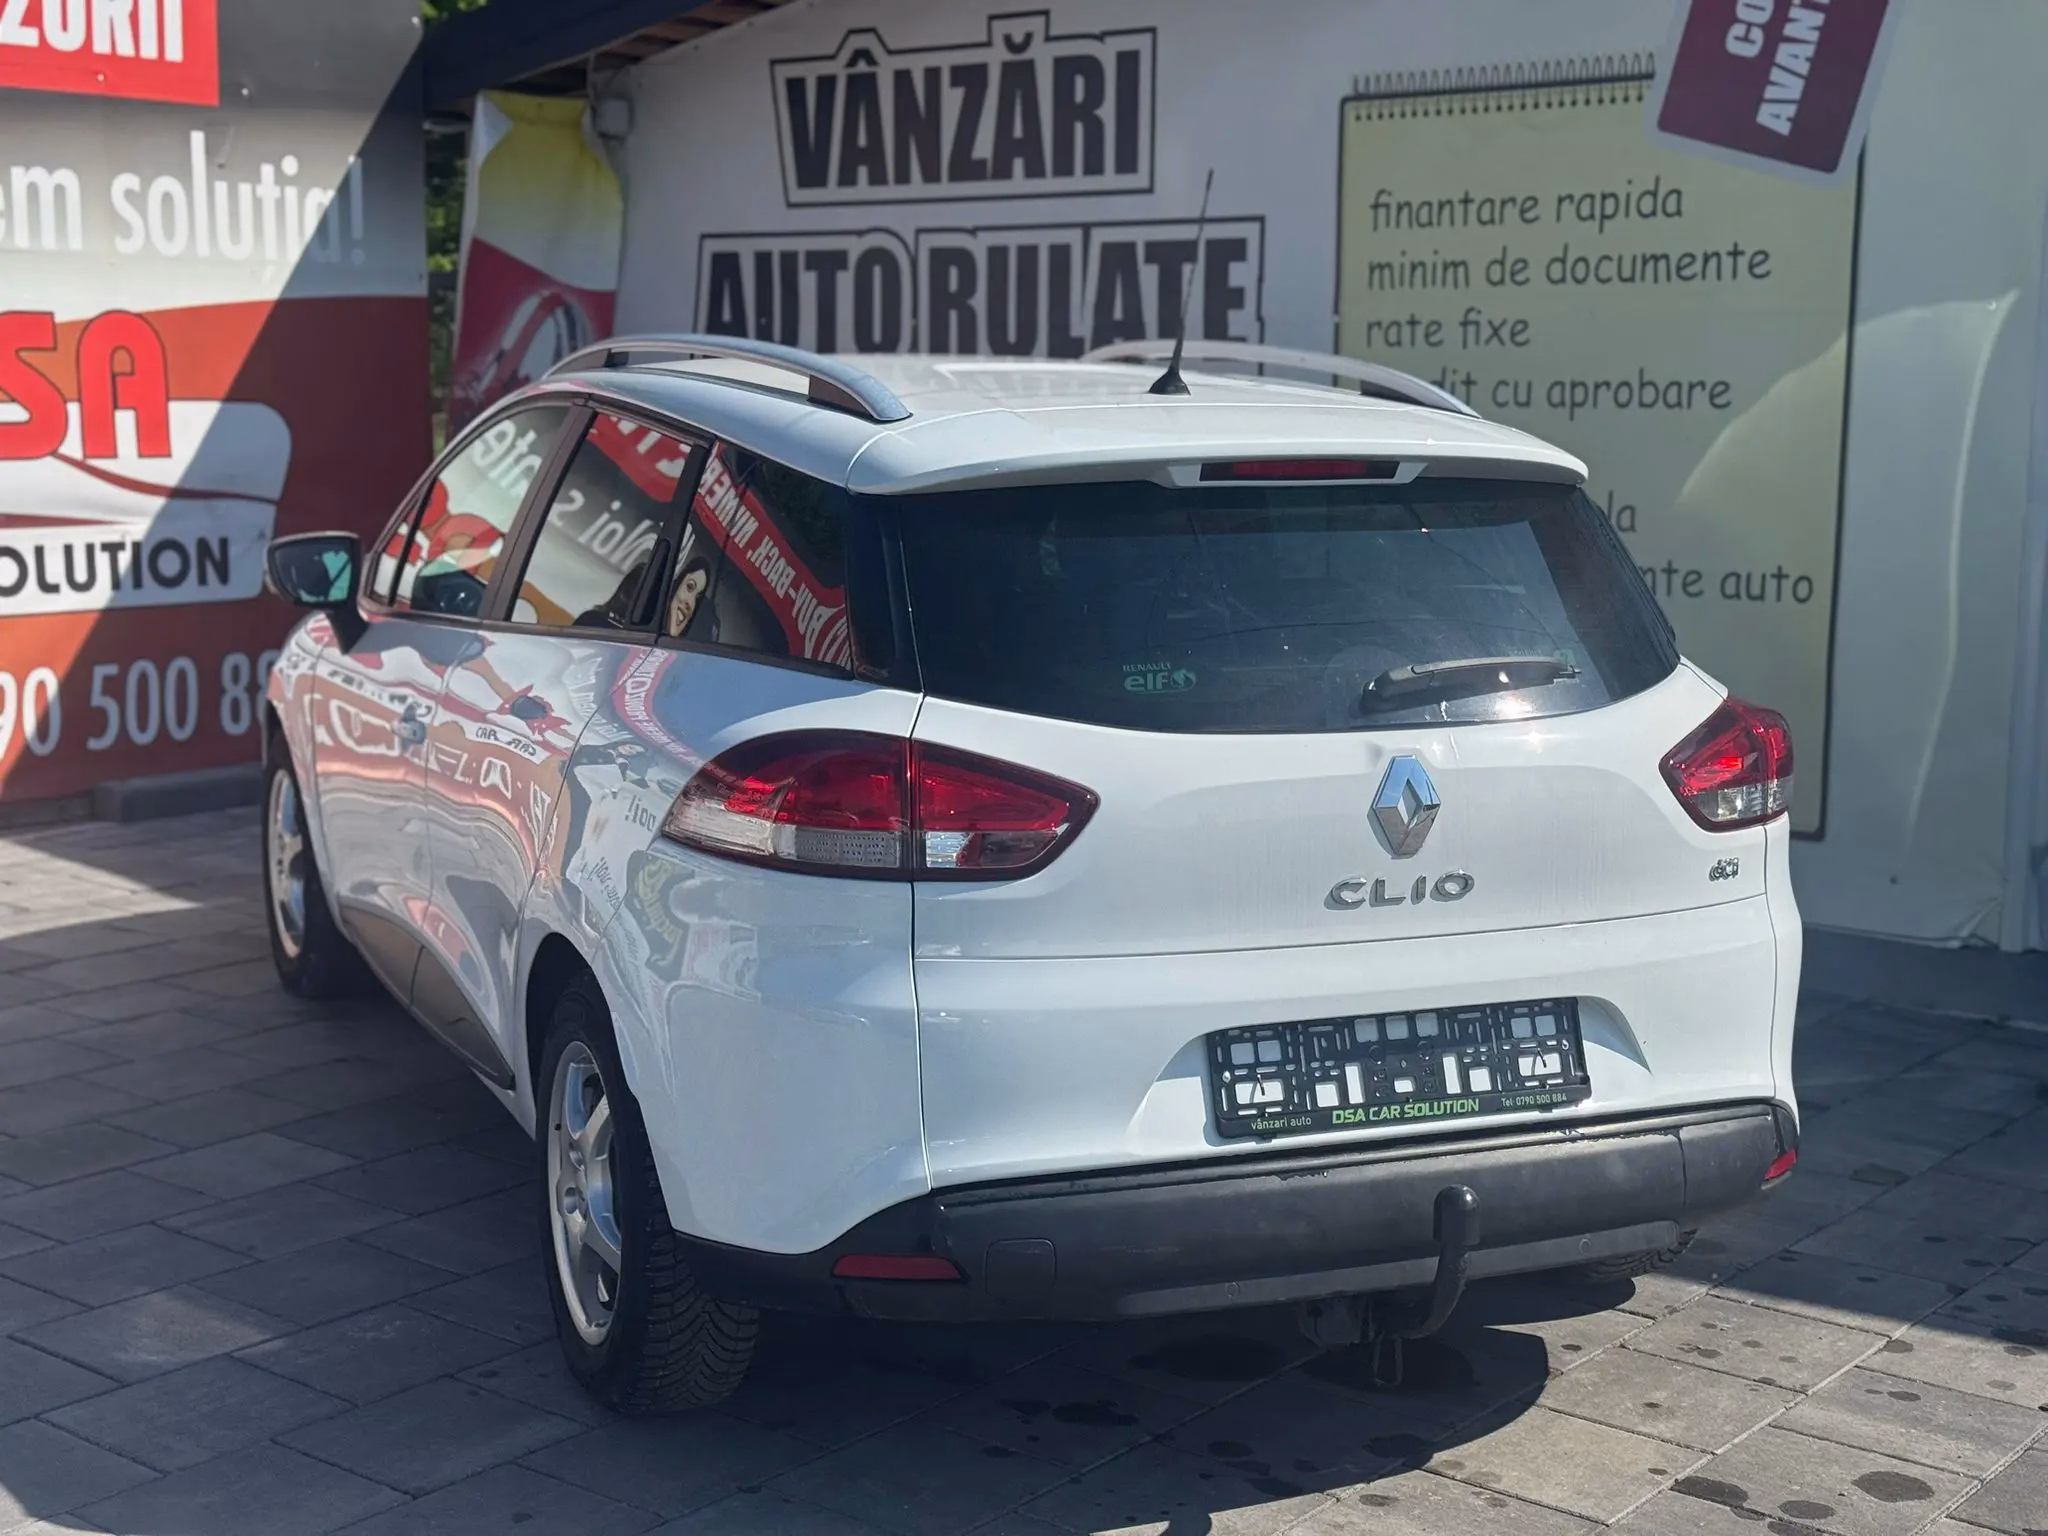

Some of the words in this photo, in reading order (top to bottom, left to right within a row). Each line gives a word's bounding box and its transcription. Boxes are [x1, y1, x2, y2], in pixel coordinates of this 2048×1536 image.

[1756, 0, 1831, 136] AVAN
[785, 31, 1141, 189] VÂNZĂRI
[1370, 188, 1540, 232] finantare
[1556, 175, 1683, 234] rapida
[1368, 250, 1470, 290] minim
[1485, 245, 1531, 287] de
[1545, 242, 1772, 285] documente
[704, 245, 906, 356] AUTO
[928, 236, 1248, 359] RULATE
[1367, 312, 1445, 349] rate
[1458, 305, 1531, 350] fixe
[1491, 379, 1533, 408] cu
[1546, 367, 1732, 421] aprobare
[1719, 565, 1814, 604] auto
[1122, 661, 1172, 673] RENAULT
[1124, 671, 1169, 692] elf
[86, 656, 198, 750] 500
[1326, 868, 1475, 909] CLIO
[1290, 1116, 1312, 1127] auto
[1332, 1109, 1367, 1124] DSA
[1369, 1104, 1400, 1121] CAR
[1403, 1098, 1480, 1119] SOLUTION
[1515, 1095, 1534, 1106] 0790
[1536, 1094, 1551, 1104] 500
[1552, 1092, 1567, 1103] 884
